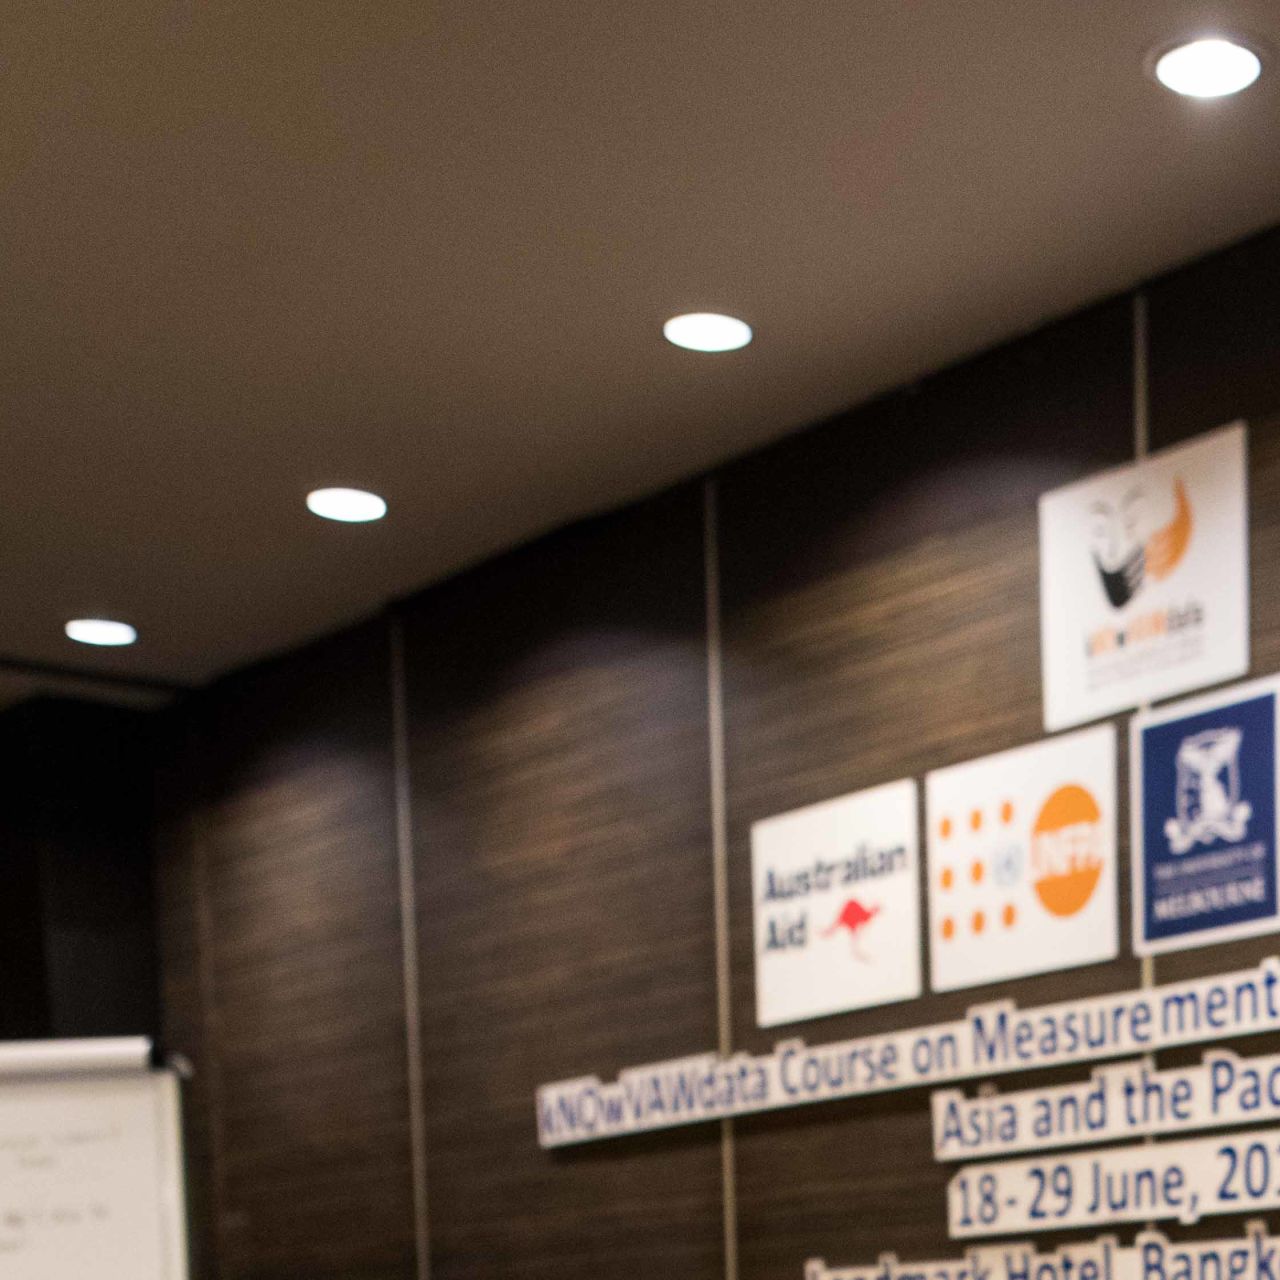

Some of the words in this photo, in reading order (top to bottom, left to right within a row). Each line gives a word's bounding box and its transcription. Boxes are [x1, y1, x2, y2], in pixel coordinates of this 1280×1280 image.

[765, 845, 906, 900] Australian
[766, 910, 807, 950] Aid
[781, 1043, 897, 1095] Course
[911, 1033, 958, 1075] on
[973, 970, 1278, 1064] Measurement
[941, 1096, 1017, 1149] Asia
[1033, 1079, 1107, 1138] and
[1124, 1066, 1193, 1126] the
[1088, 1161, 1198, 1213] June,
